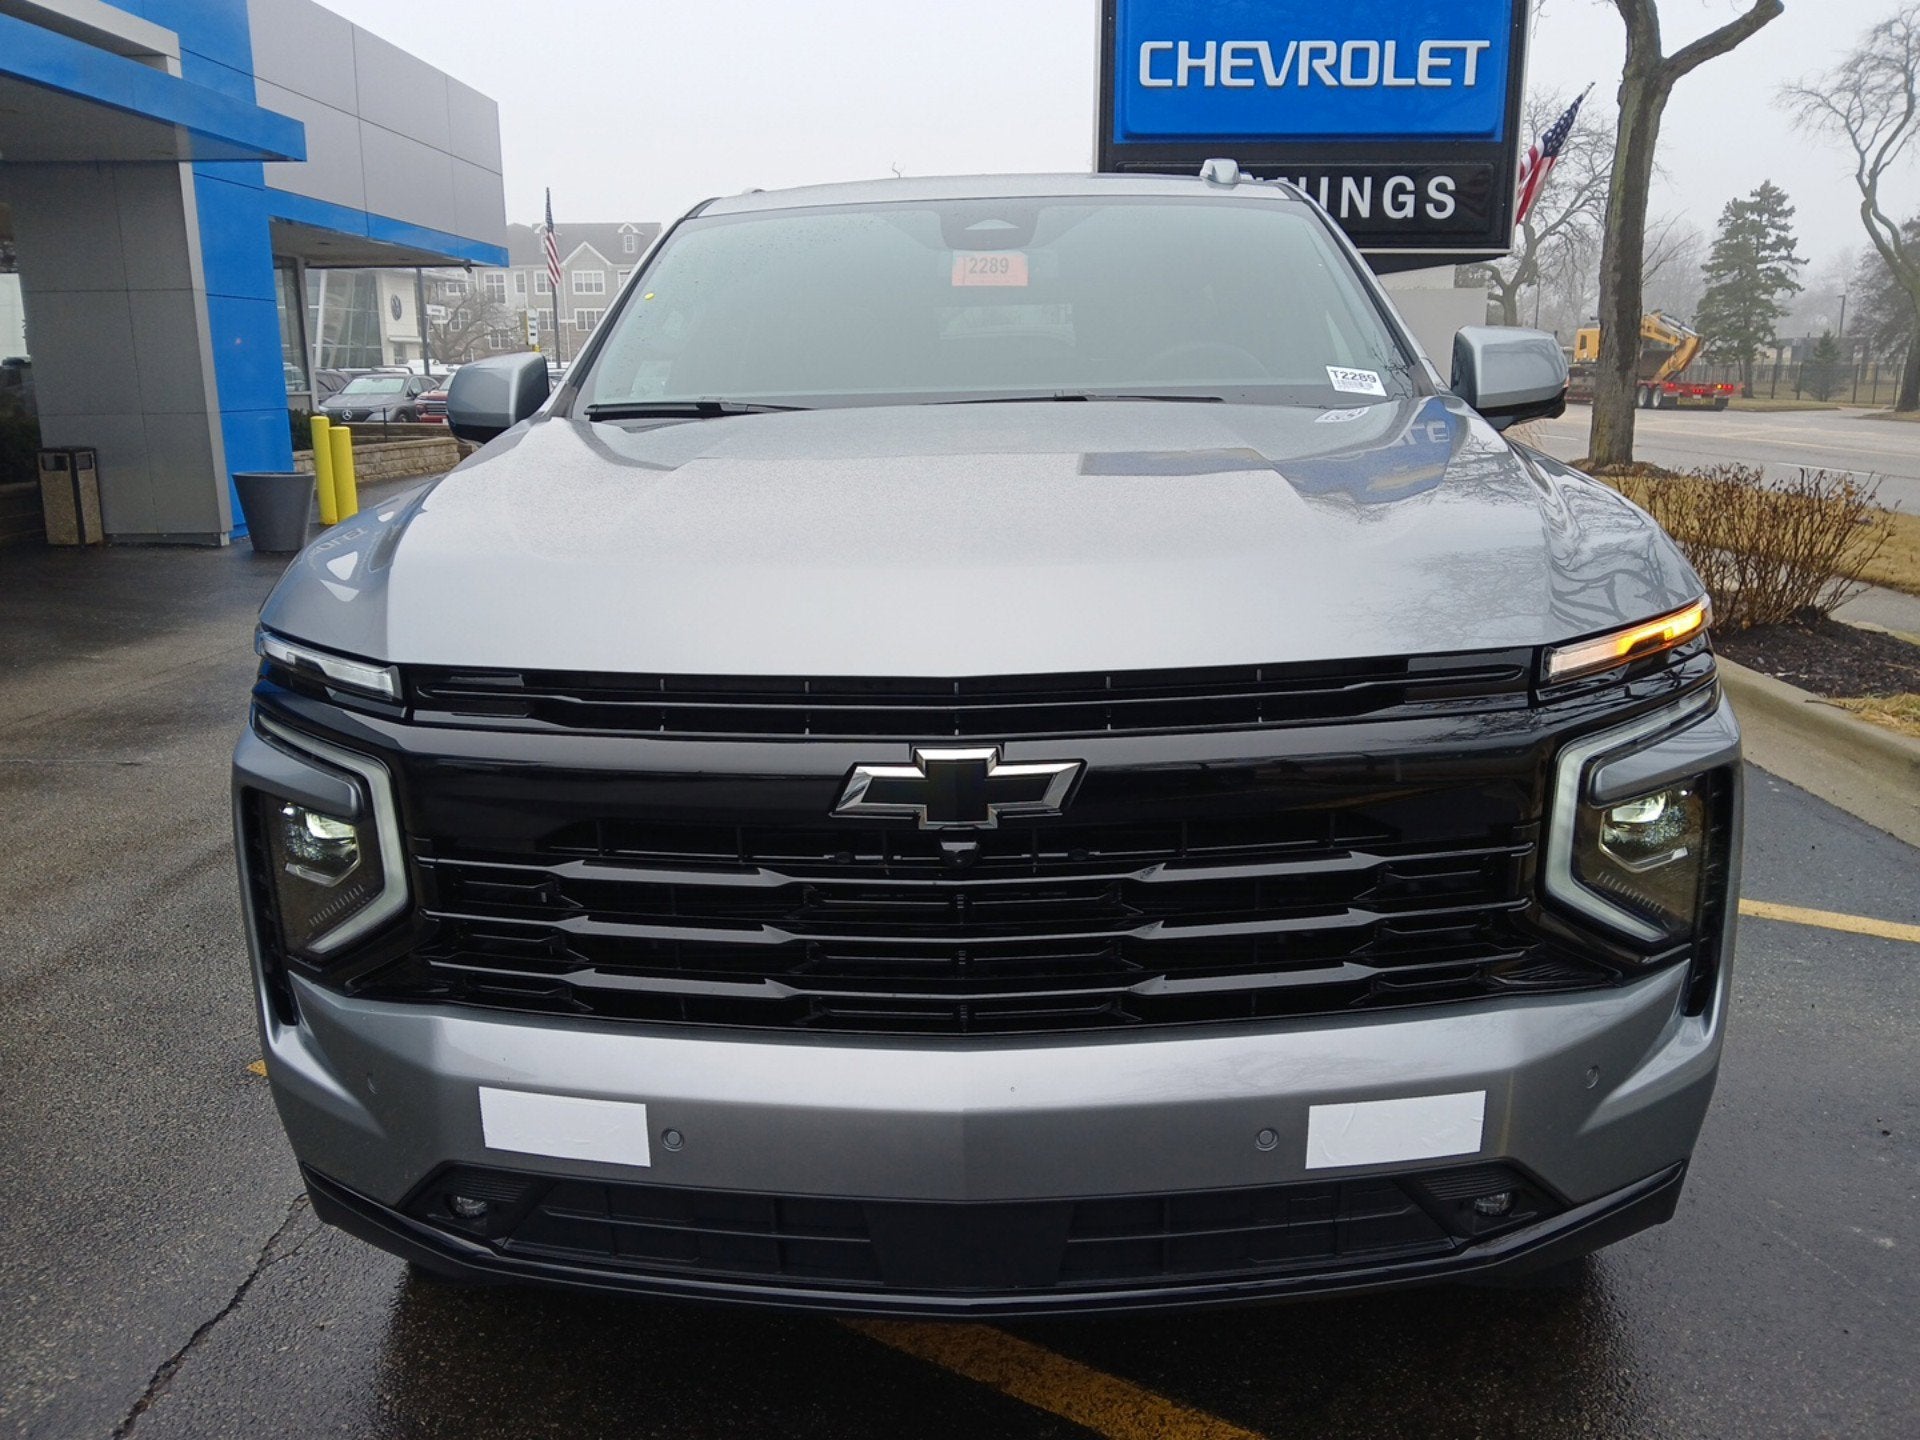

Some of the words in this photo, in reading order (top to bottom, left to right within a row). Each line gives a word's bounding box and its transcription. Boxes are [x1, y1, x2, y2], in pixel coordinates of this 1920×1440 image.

[1138, 40, 1491, 87] CHEVROLET
[968, 257, 1009, 274] 2289
[1330, 371, 1377, 384] T2289
